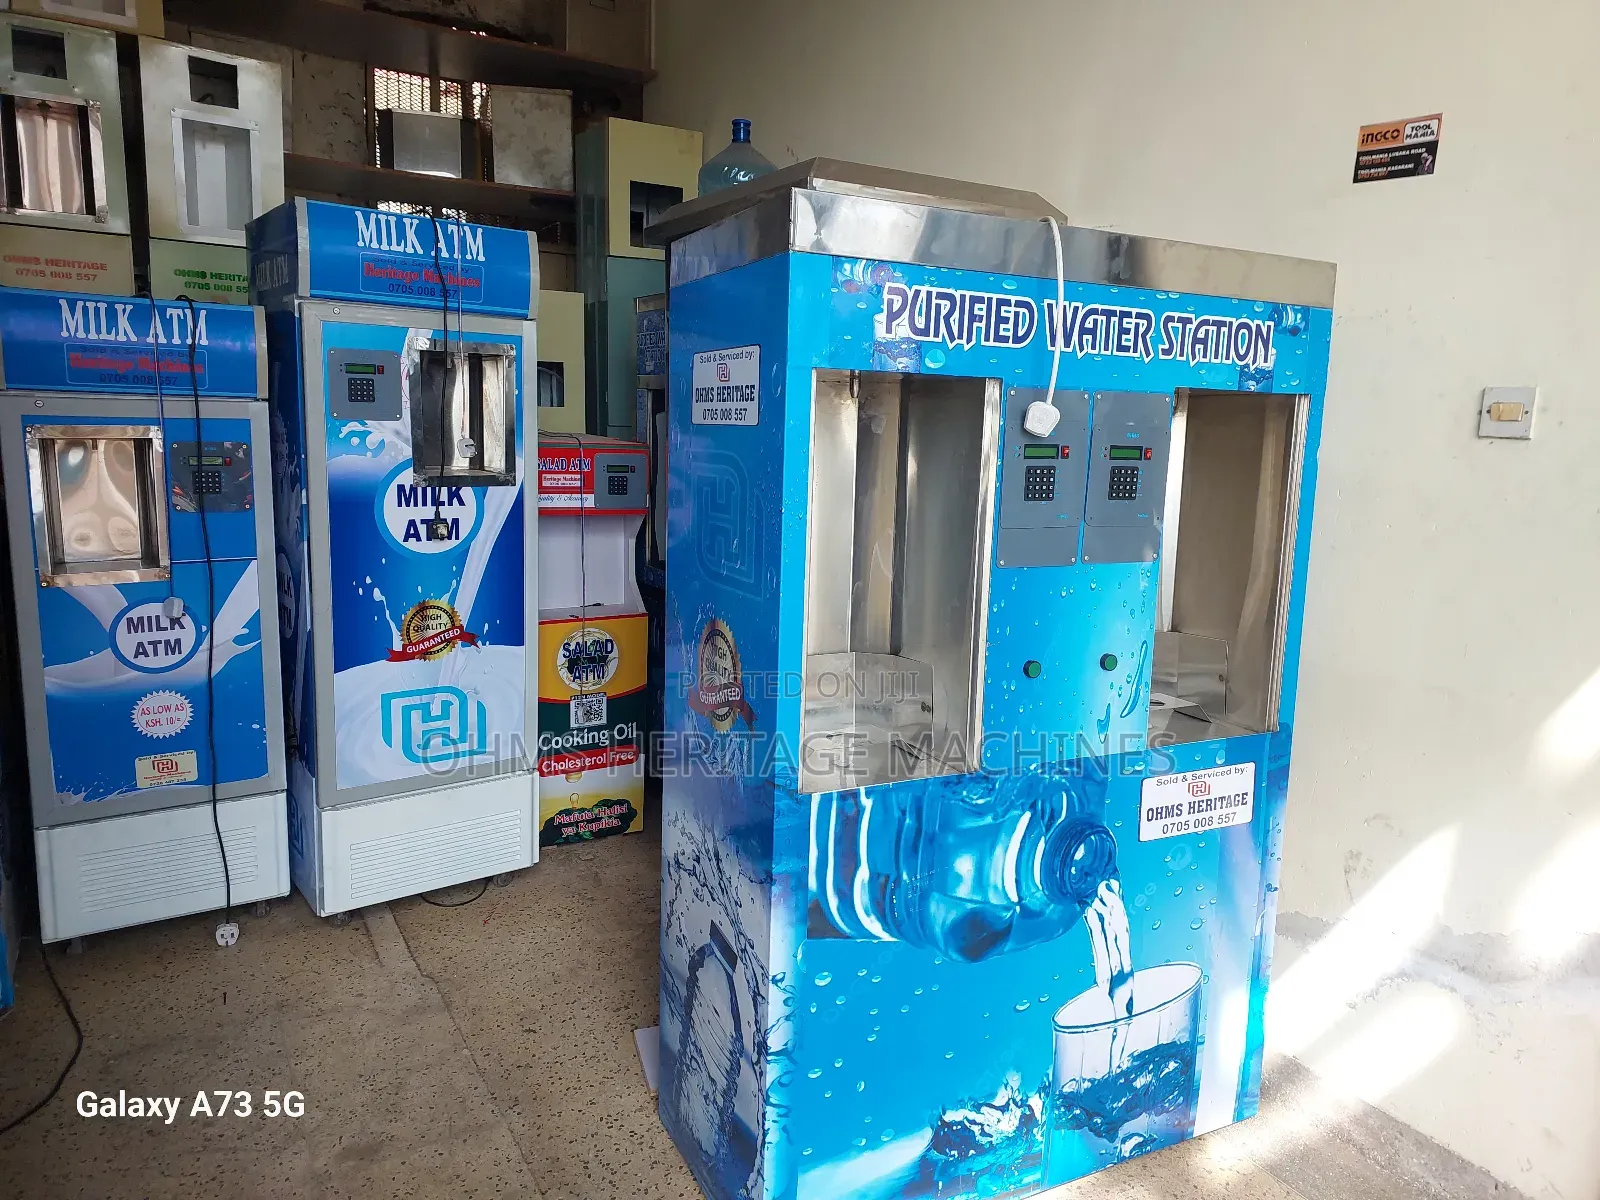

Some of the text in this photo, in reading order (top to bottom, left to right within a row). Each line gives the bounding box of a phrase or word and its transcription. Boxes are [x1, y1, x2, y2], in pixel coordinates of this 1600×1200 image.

[1405, 130, 1436, 140] MANIA
[1410, 123, 1433, 133] TOOL
[354, 210, 486, 262] MILK ATM
[45, 256, 108, 271] HERITAGE
[363, 262, 420, 285] Heritage
[15, 267, 98, 282] 0705 008 557
[184, 280, 212, 291] 0705
[214, 282, 234, 293] 008
[388, 283, 414, 294] 0705
[416, 286, 436, 297] 008
[58, 299, 209, 346] MILK ATM
[884, 284, 1275, 369] PURIFIED WATER STATION
[69, 353, 134, 374] Heritage
[699, 350, 755, 364] Sold & Serviced by:
[99, 373, 130, 384] 0705
[132, 375, 154, 385] 008
[695, 384, 756, 404] OHMS HERITAGE
[702, 408, 748, 422] 0705 008 557
[569, 457, 592, 472] ATM
[396, 483, 466, 508] MILK
[402, 518, 460, 543] ATM
[126, 613, 186, 635] MILK
[412, 621, 449, 633] QUALITY
[420, 614, 442, 623] HIGH
[133, 637, 183, 660] ATM
[406, 628, 461, 654] GUARANTEED
[562, 638, 615, 659] SALAD
[572, 664, 606, 682] ATM
[699, 688, 741, 705] GUARANTEED
[140, 702, 185, 716] AS LOW AS
[145, 716, 182, 728] KSH. 10/=
[538, 722, 637, 751] Cooking Oil
[542, 751, 635, 773] Cholesterol Free
[1156, 766, 1248, 787] Sold & Serviced by:
[554, 802, 628, 826] Mafuta Halisi
[1146, 792, 1249, 823] OHMS HERITAGE
[562, 818, 621, 838] ya Kupikia
[1162, 812, 1238, 835] 0705 008 557
